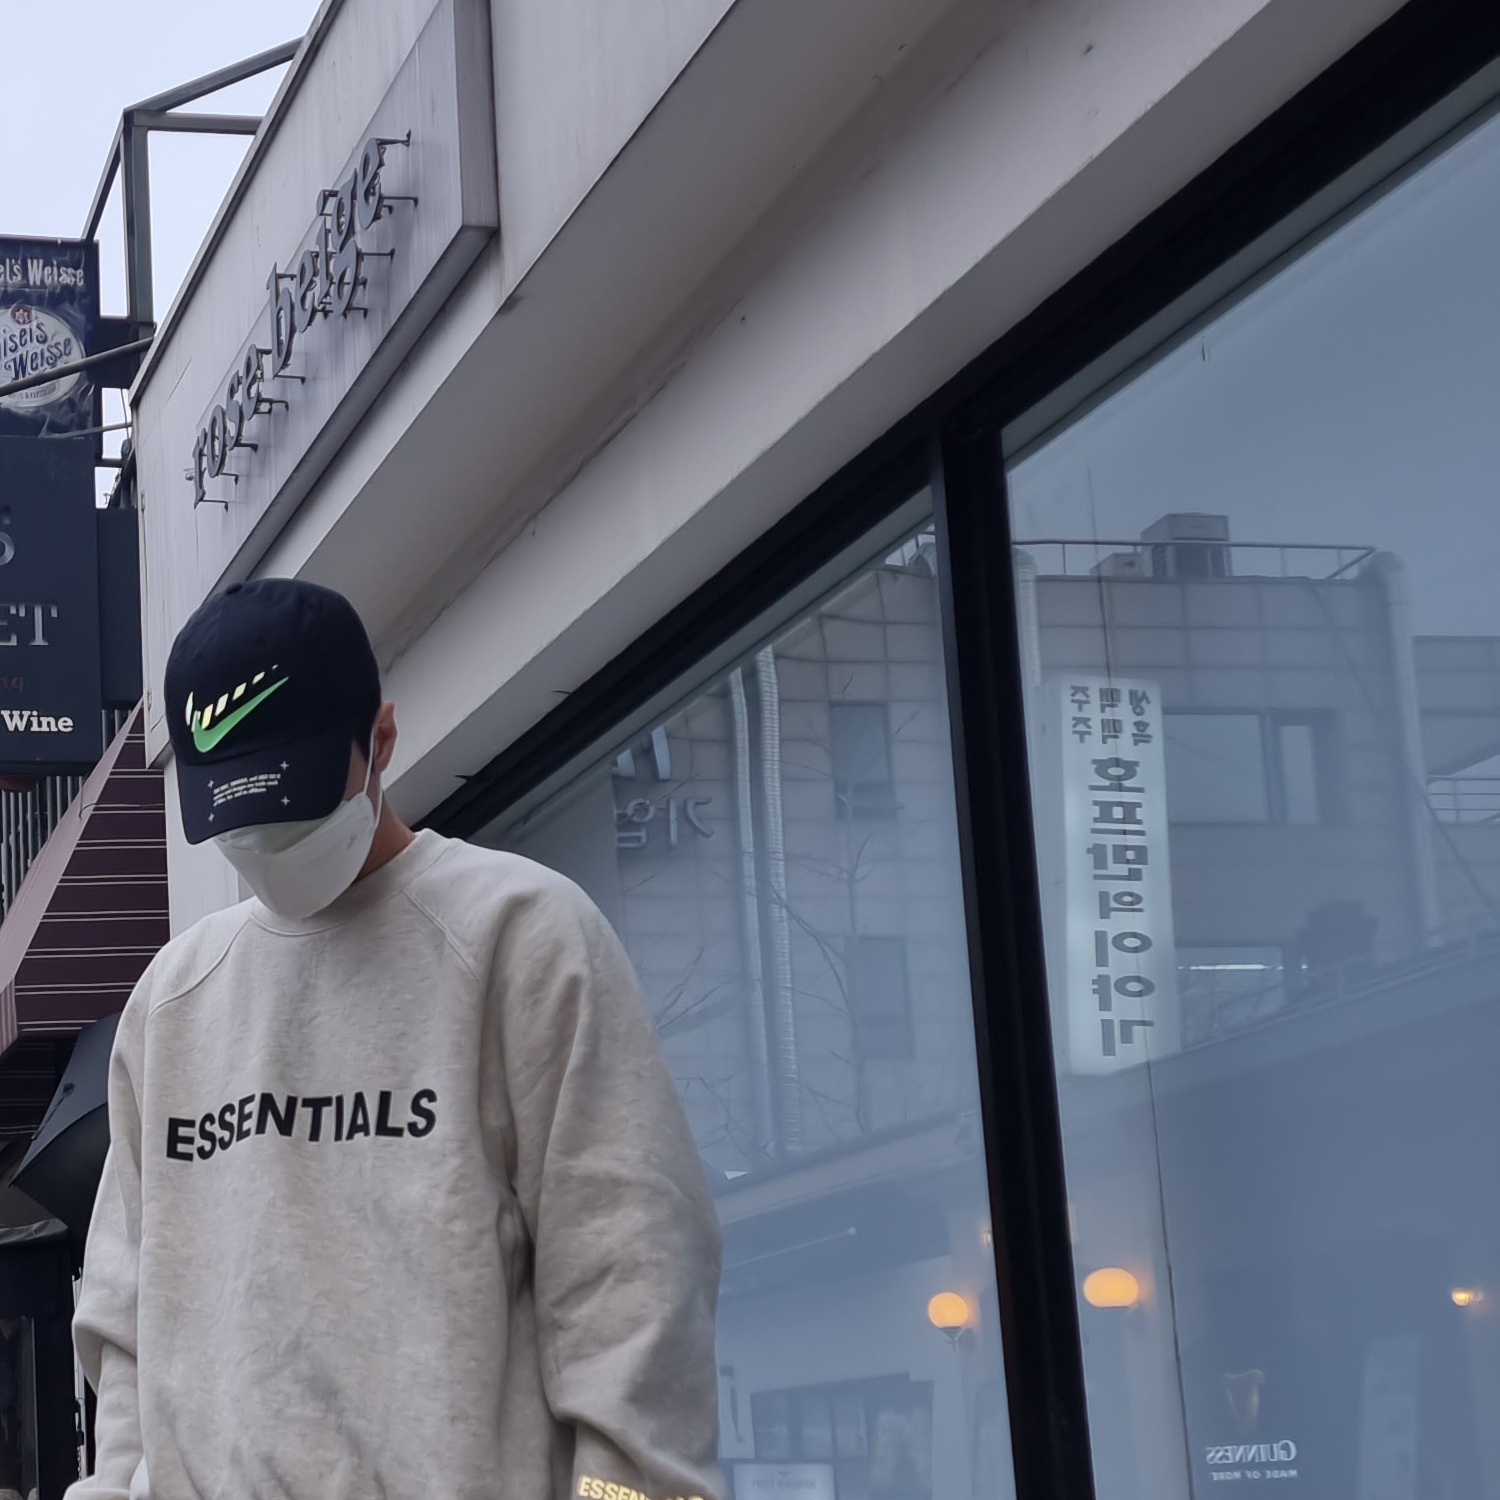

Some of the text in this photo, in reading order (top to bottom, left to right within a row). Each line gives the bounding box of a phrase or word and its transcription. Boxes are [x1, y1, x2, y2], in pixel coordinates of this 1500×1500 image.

[27, 258, 85, 287] Weisse
[4, 337, 72, 380] Weisse
[192, 343, 260, 509] rose
[0, 710, 74, 733] Wine
[166, 1088, 438, 1162] ESSENTIALS
